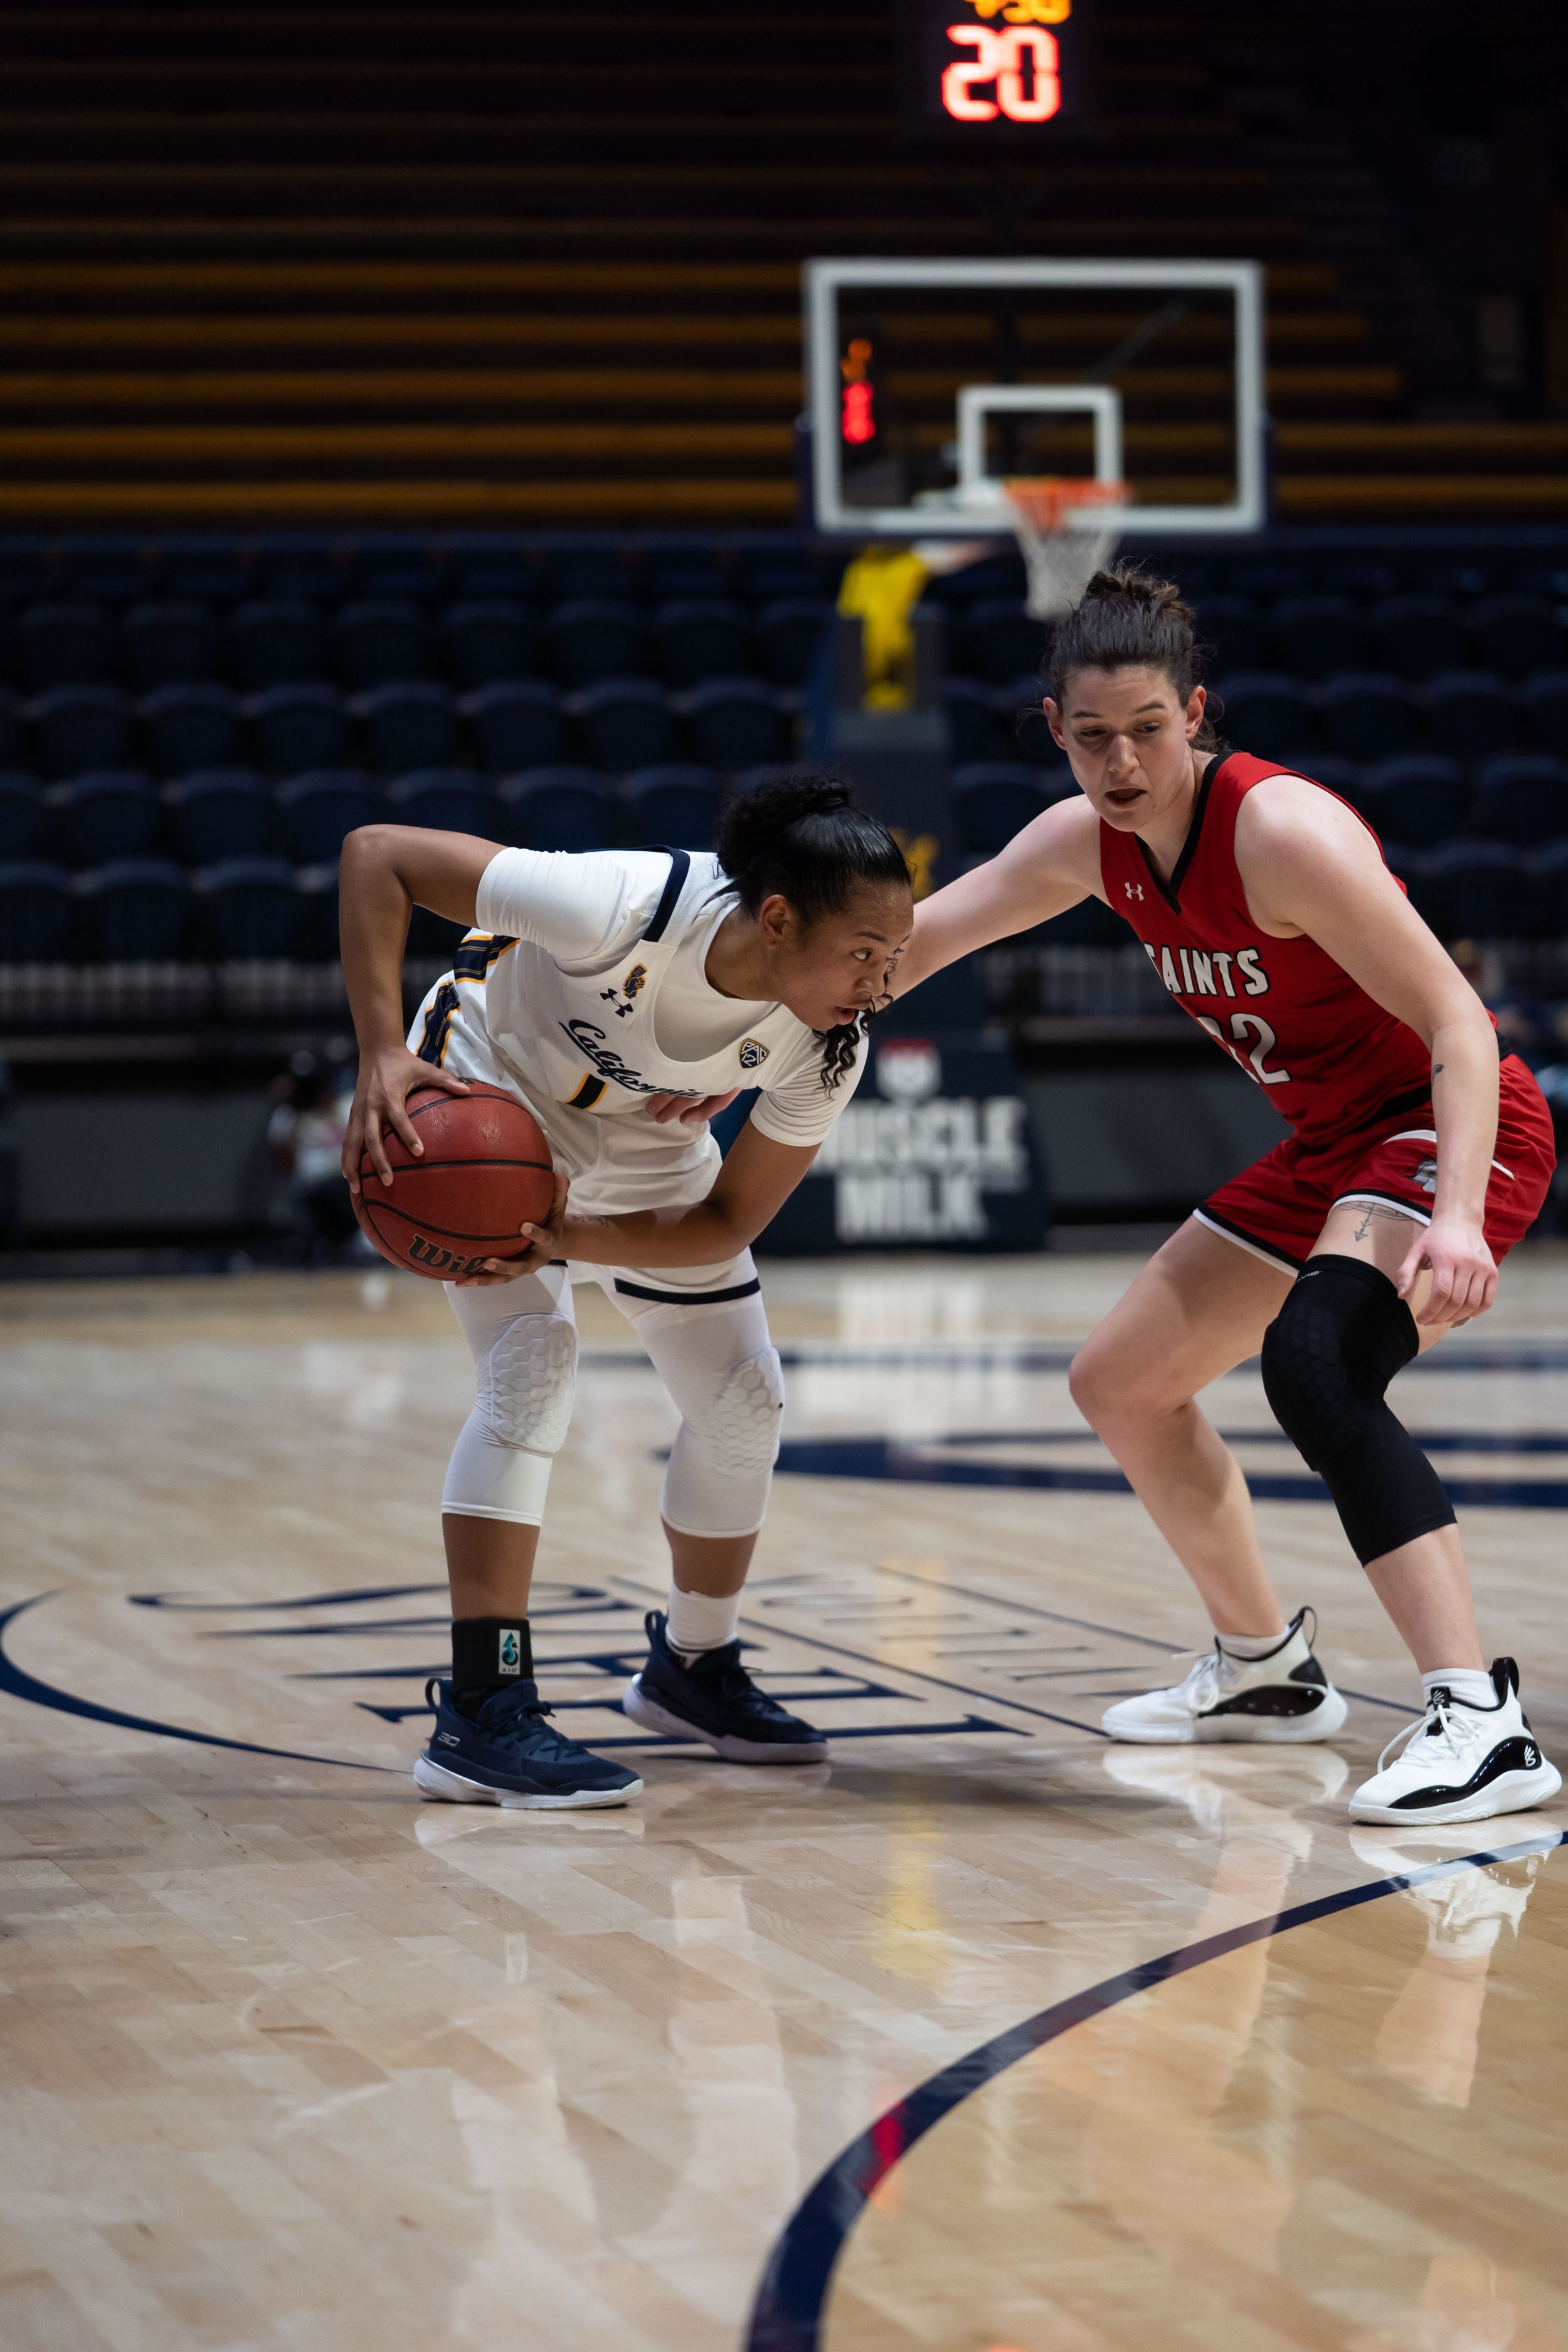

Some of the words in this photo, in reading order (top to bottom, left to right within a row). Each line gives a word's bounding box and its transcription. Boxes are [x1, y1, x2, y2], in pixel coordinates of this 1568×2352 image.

[942, 24, 1062, 122] 20
[835, 1172, 987, 1242] MILK
[408, 1233, 488, 1276] Wil
